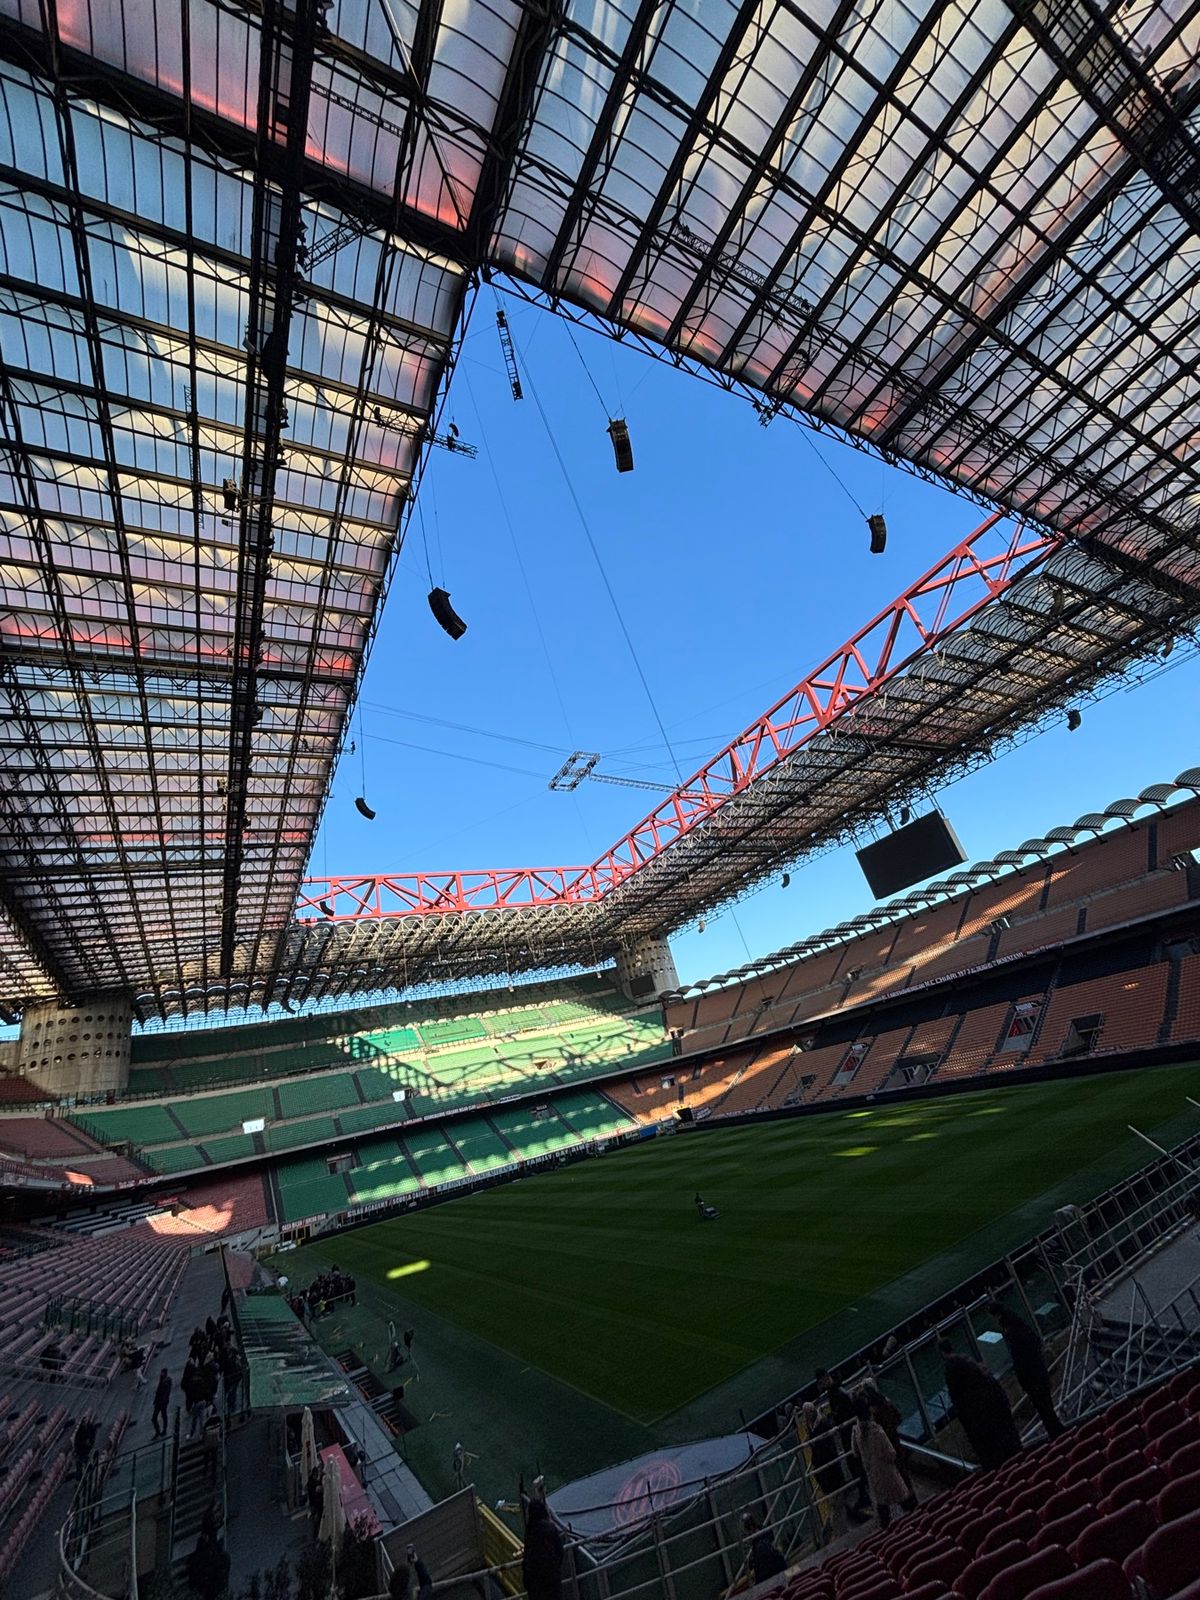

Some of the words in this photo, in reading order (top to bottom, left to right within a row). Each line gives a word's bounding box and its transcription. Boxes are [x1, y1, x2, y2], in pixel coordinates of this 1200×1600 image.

[526, 1154, 552, 1166] FAMILY
[555, 1149, 569, 1158] DAY
[489, 1166, 510, 1177] MILAN
[364, 1201, 388, 1213] ACADEMY
[392, 1194, 412, 1205] SCUOLA
